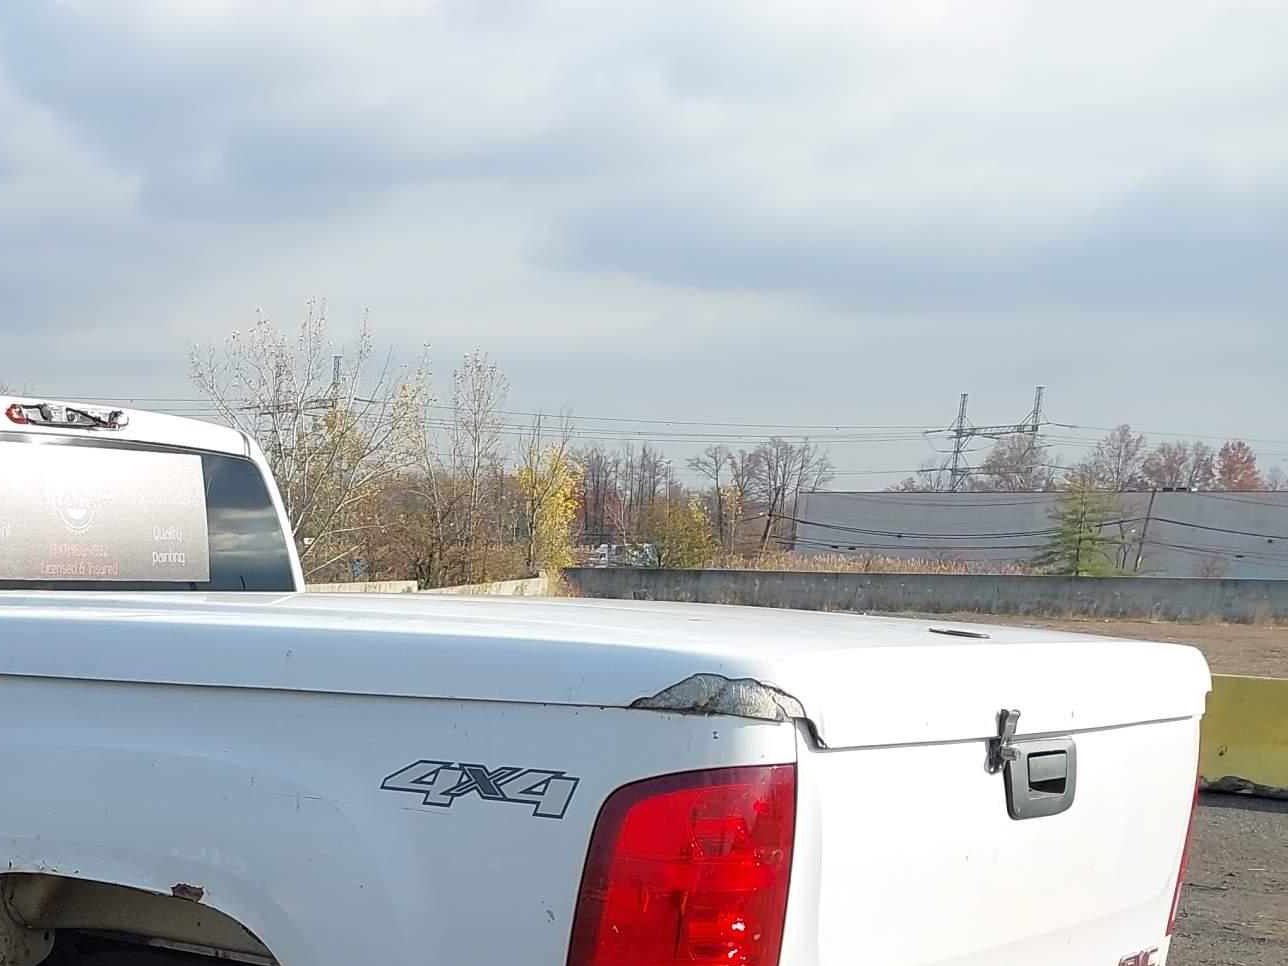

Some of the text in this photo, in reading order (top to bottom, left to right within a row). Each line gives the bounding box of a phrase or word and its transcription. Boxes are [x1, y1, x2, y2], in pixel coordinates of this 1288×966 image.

[153, 525, 182, 543] Quality
[152, 549, 186, 566] painting
[40, 561, 77, 575] Licensed
